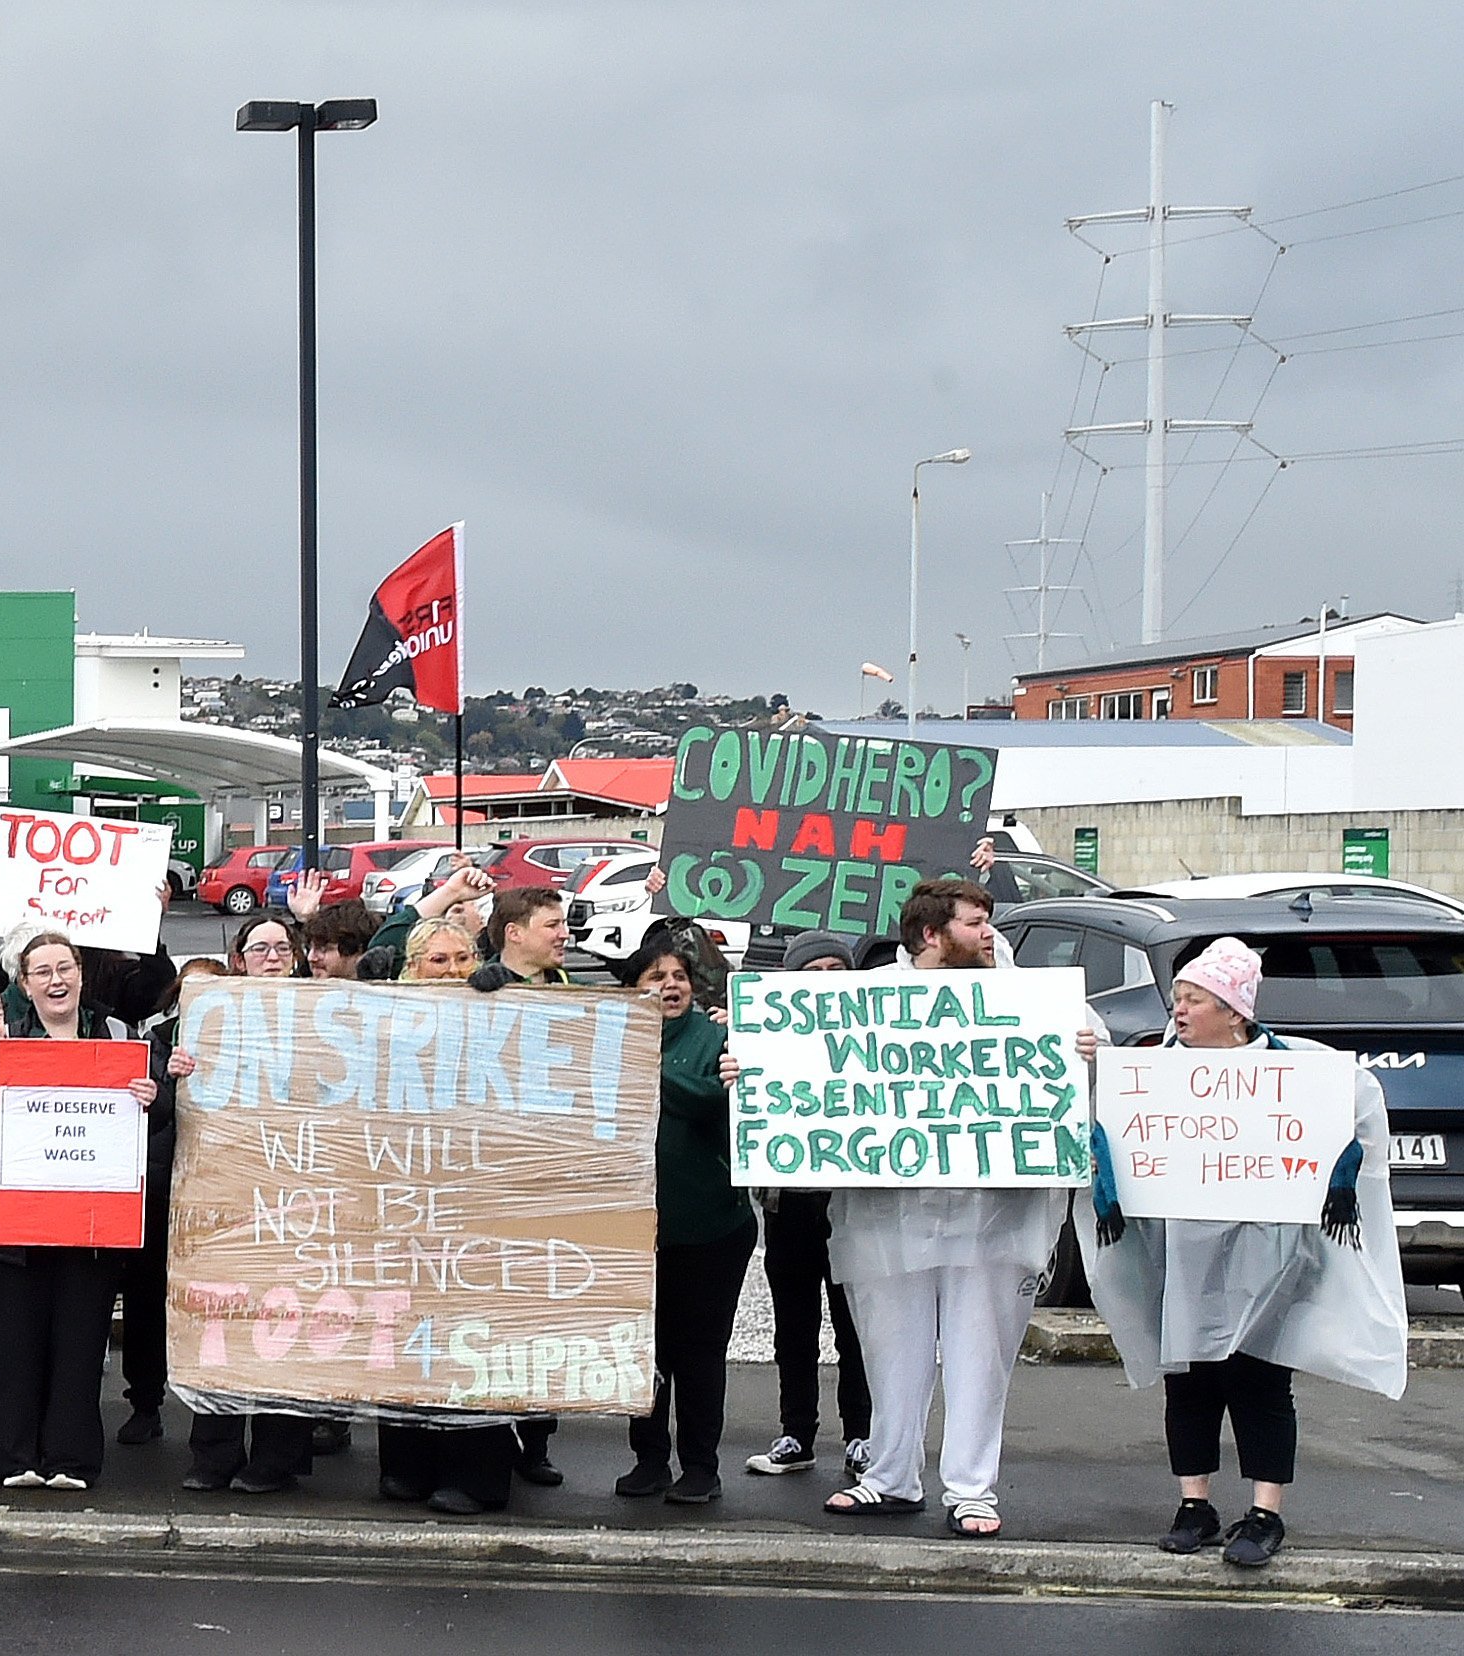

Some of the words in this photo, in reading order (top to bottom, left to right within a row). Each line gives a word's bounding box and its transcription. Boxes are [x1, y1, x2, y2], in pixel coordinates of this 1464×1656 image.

[0, 814, 139, 865] TOOT
[732, 807, 908, 862] NAH
[772, 857, 962, 935] ZER
[731, 972, 1020, 1034] ESSENTIAL
[186, 990, 294, 1112] ON
[313, 991, 630, 1140] STRIKE!
[825, 1032, 1067, 1079] WORKERS
[27, 1101, 50, 1113] WE
[54, 1102, 116, 1114] DESERVE
[736, 1067, 1077, 1121] ESSENTIALLY
[1120, 1066, 1152, 1094] I
[1190, 1065, 1295, 1103] CAN'T
[55, 1125, 86, 1138] FAIR
[259, 1119, 339, 1174] WE
[364, 1122, 505, 1176] WILL
[736, 1119, 1090, 1178] FORGOTTEN
[1122, 1112, 1239, 1142] AFFORD
[1267, 1114, 1303, 1142] TO
[1388, 1138, 1439, 1160] 141
[44, 1149, 95, 1161] WAGES
[1131, 1151, 1168, 1178] BE
[253, 1186, 352, 1244] NOT
[376, 1183, 465, 1233] BE
[294, 1238, 595, 1299] SILENCED
[186, 1281, 410, 1370] TOOT
[402, 1318, 442, 1379] 4
